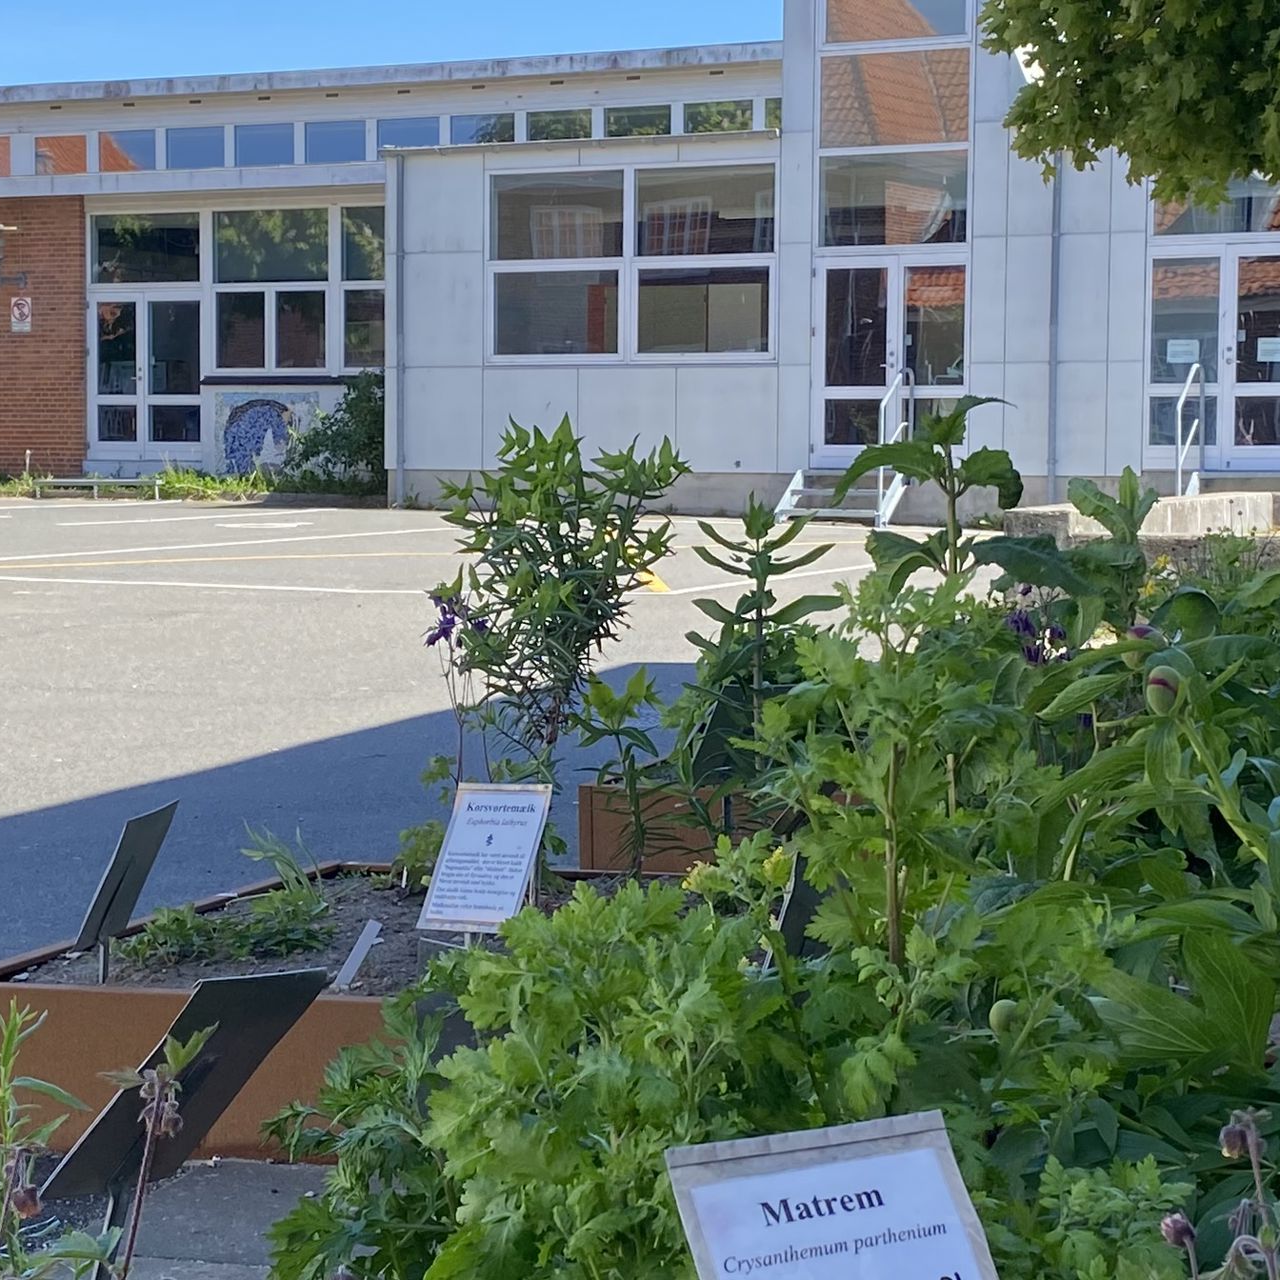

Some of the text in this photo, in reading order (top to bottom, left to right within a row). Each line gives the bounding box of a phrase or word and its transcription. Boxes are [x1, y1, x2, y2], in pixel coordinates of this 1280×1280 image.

[758, 1187, 885, 1228] Matrem
[723, 1221, 948, 1276] Crysanthemum parthenium
